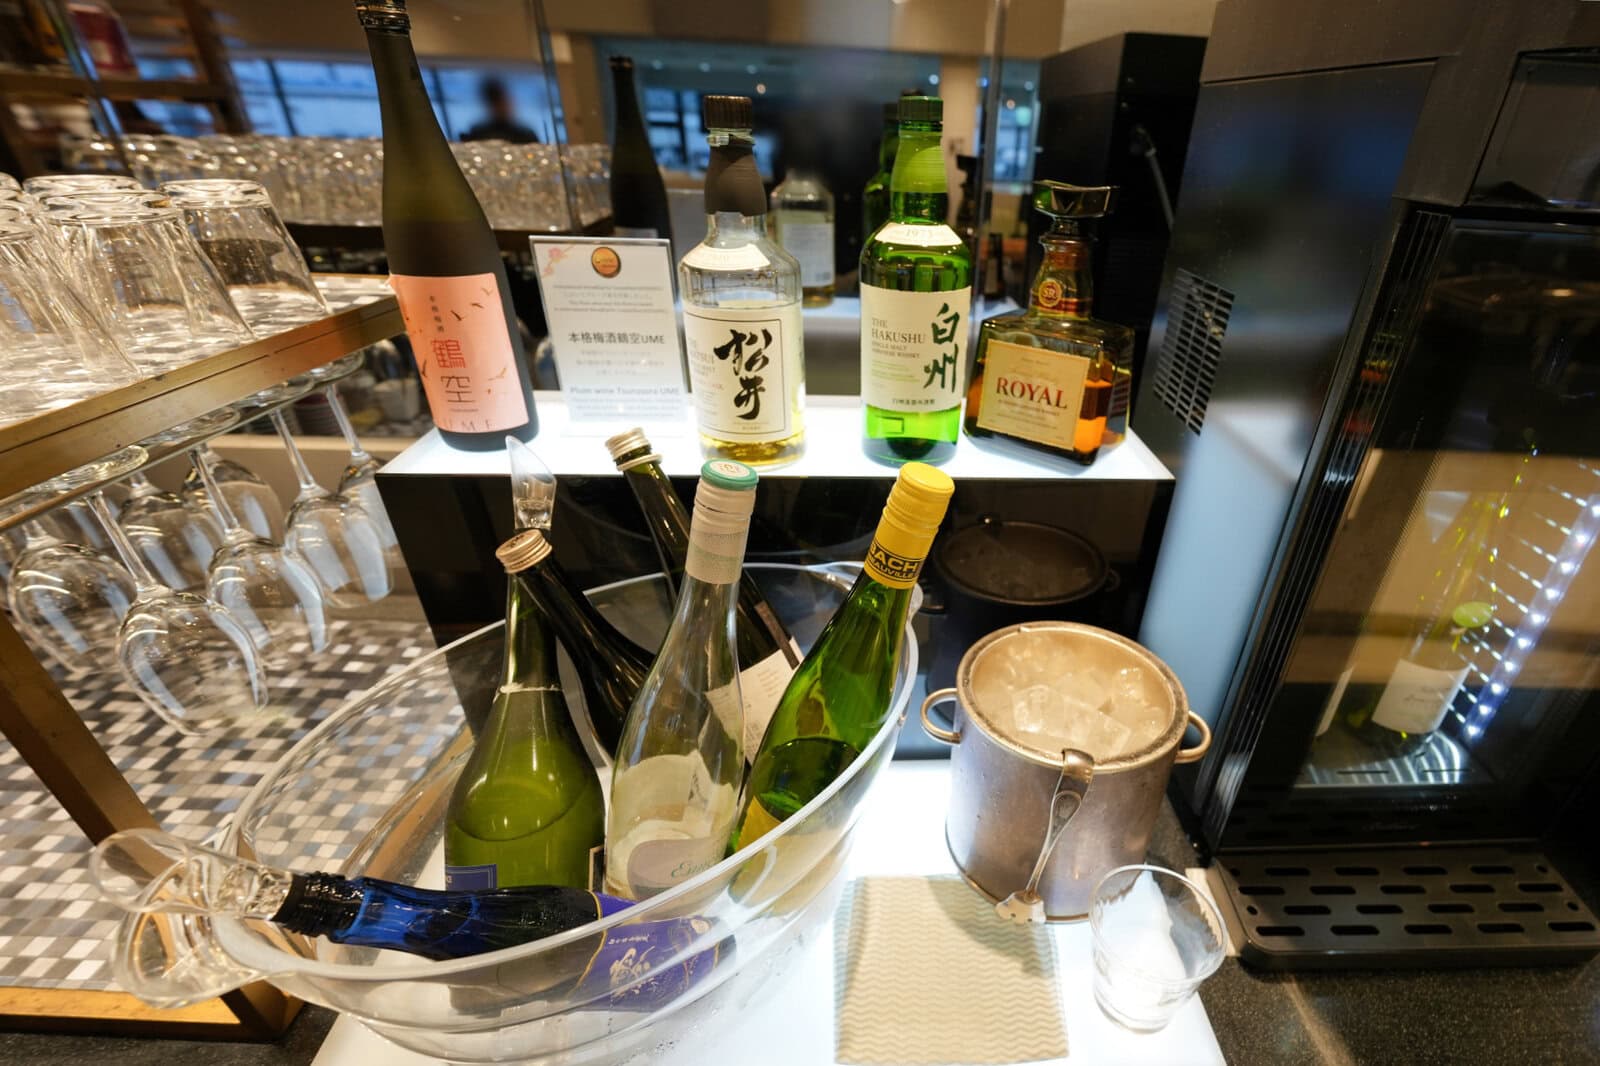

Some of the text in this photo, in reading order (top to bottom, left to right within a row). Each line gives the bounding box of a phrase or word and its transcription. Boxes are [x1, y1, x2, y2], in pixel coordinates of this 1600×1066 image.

[872, 318, 888, 329] THE
[872, 328, 926, 344] HAKUSHU
[923, 303, 961, 392] 白州
[430, 339, 477, 403] 鶴空
[713, 329, 773, 420] 松井
[996, 376, 1068, 410] ROYAL
